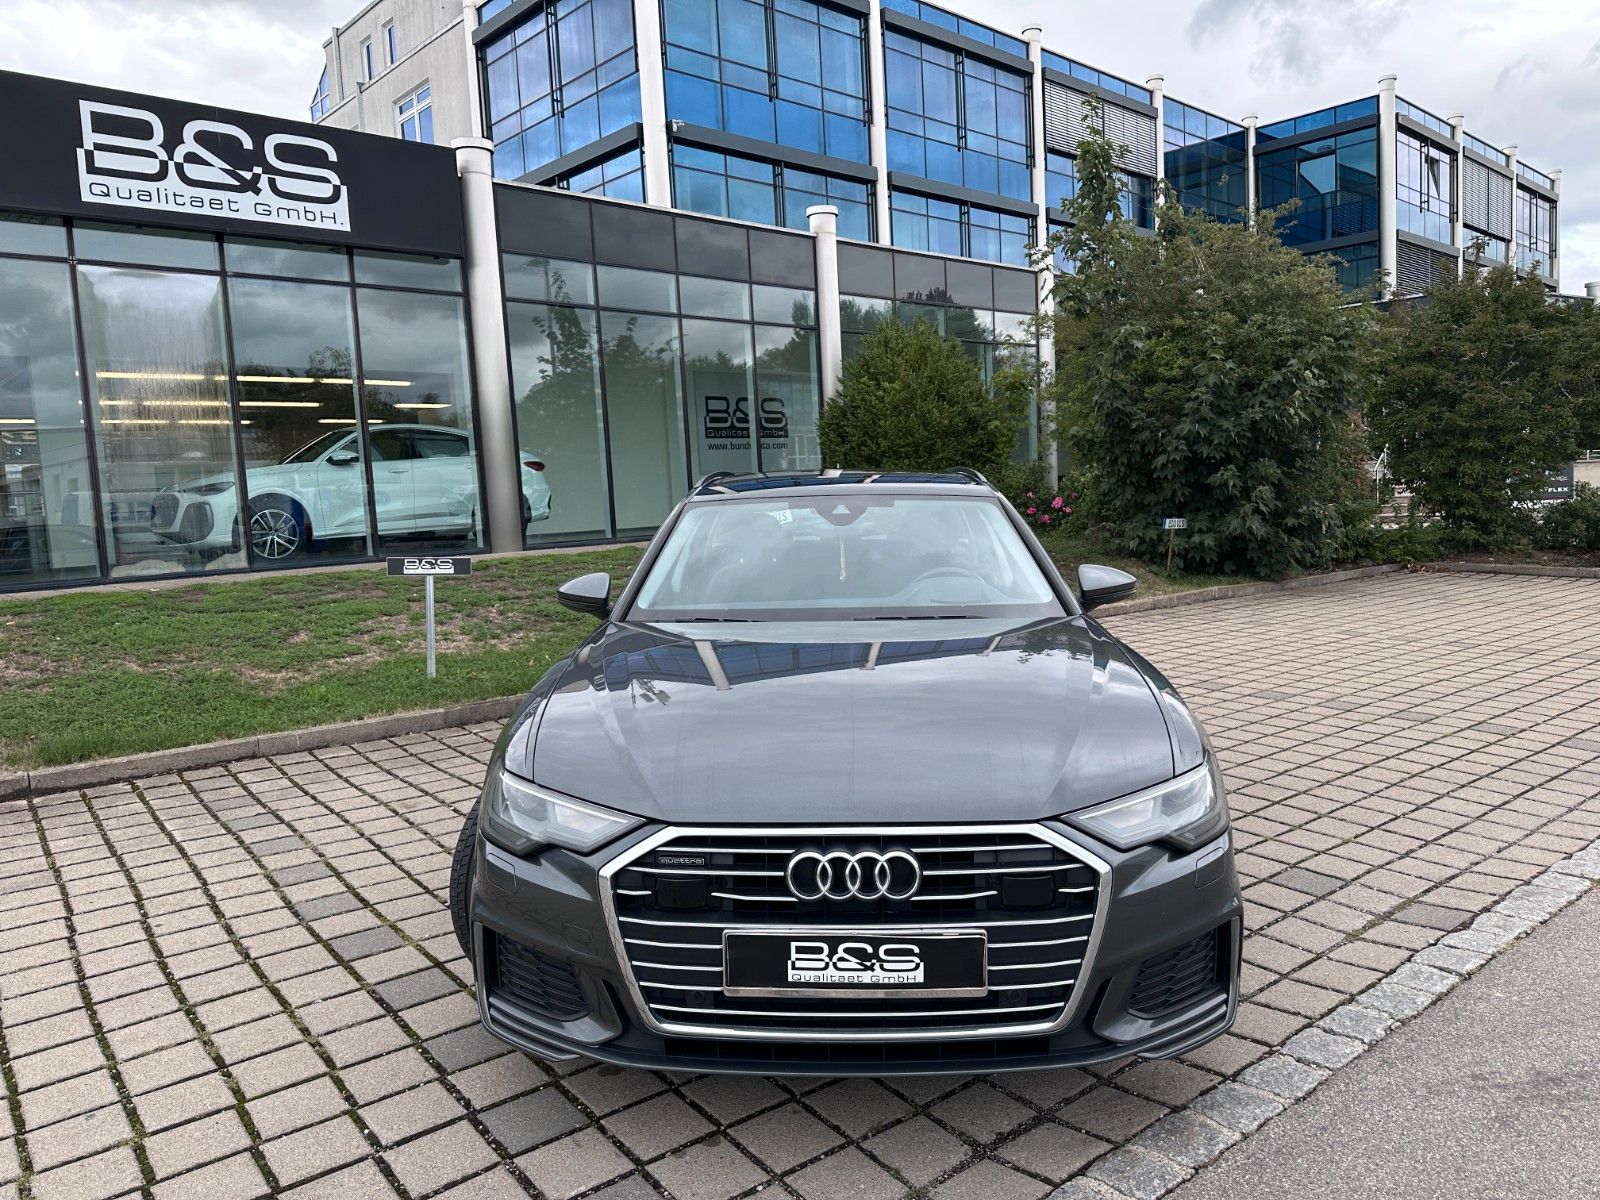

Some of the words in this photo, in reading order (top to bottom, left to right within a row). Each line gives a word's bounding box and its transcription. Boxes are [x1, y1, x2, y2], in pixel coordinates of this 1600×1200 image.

[78, 99, 342, 205] B&S
[89, 182, 240, 213] Qualitaet
[253, 202, 344, 226] GmbH.
[704, 395, 786, 428] B&S
[706, 429, 749, 437] Qualitae
[404, 558, 453, 570] B&S
[660, 857, 703, 865] quattro
[790, 941, 921, 973] B&S
[791, 973, 864, 983] Qualitaet
